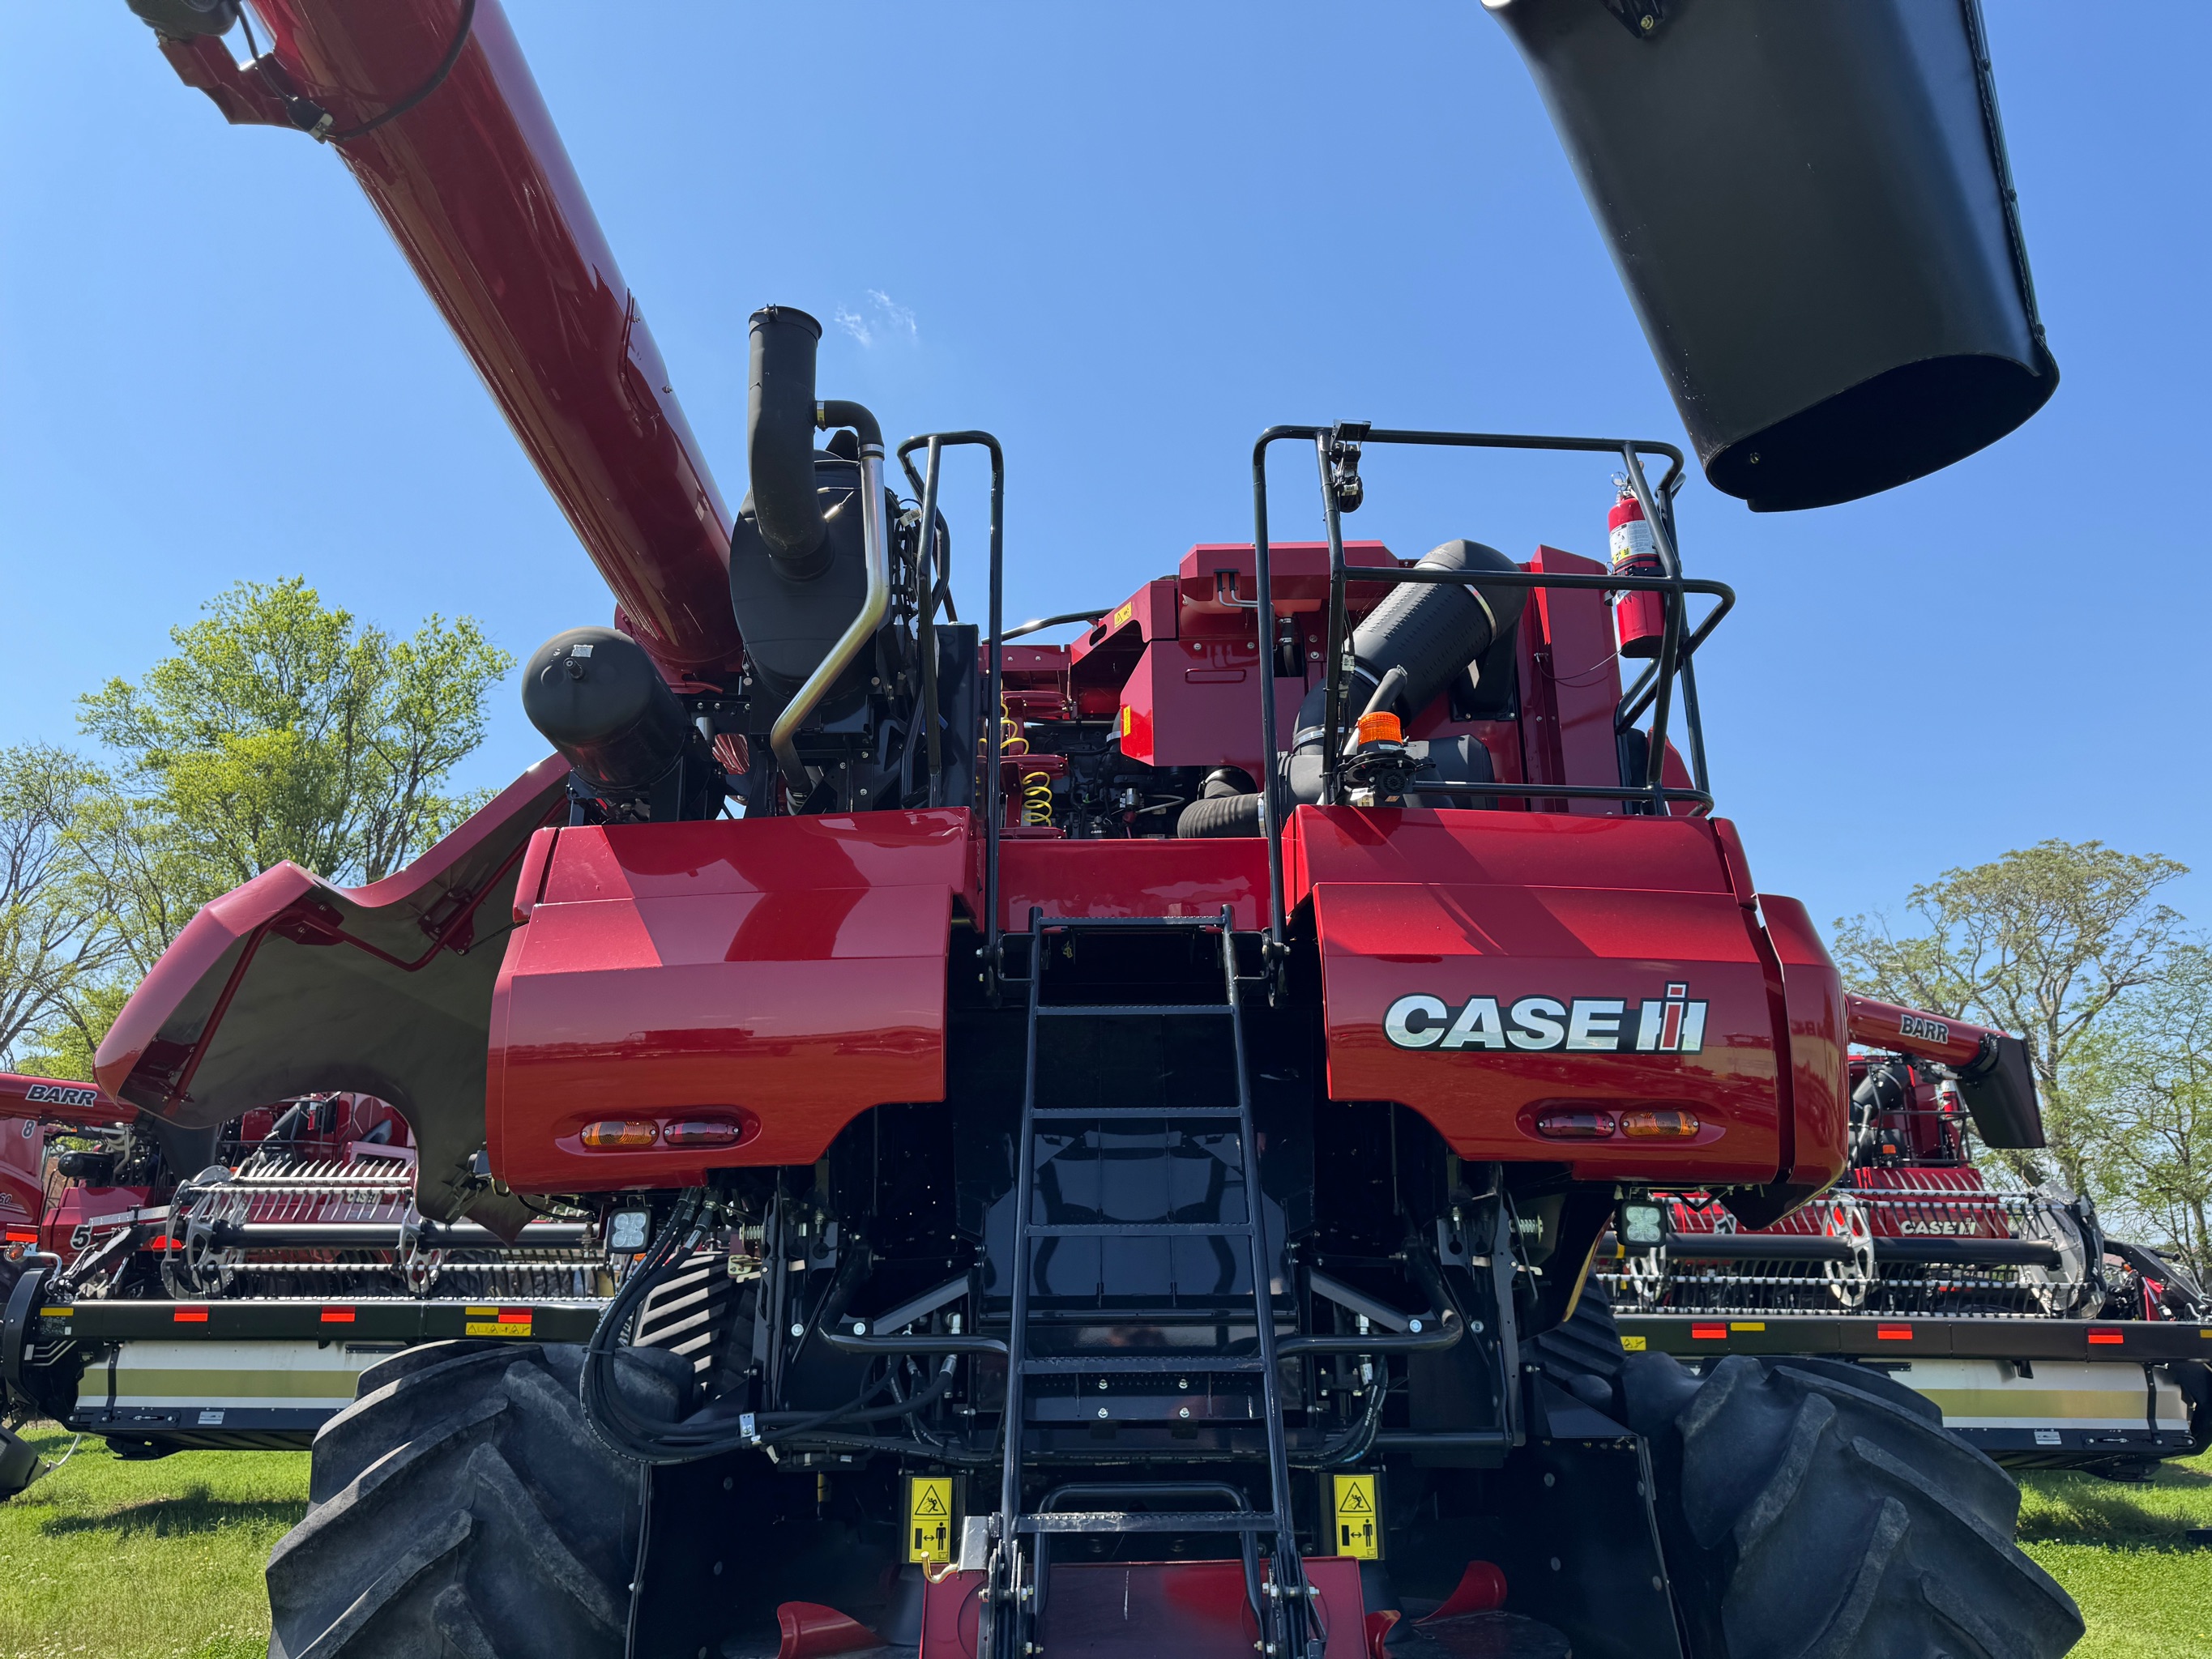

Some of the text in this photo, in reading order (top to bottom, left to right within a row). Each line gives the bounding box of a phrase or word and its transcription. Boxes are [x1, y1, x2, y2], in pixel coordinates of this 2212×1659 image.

[1385, 983, 1707, 1051] CASE IH
[1899, 1013, 1949, 1045] BARR
[25, 1084, 97, 1107] BARR
[22, 1120, 36, 1139] 8
[70, 1224, 93, 1250] 5
[1900, 1220, 1957, 1235] CASE
